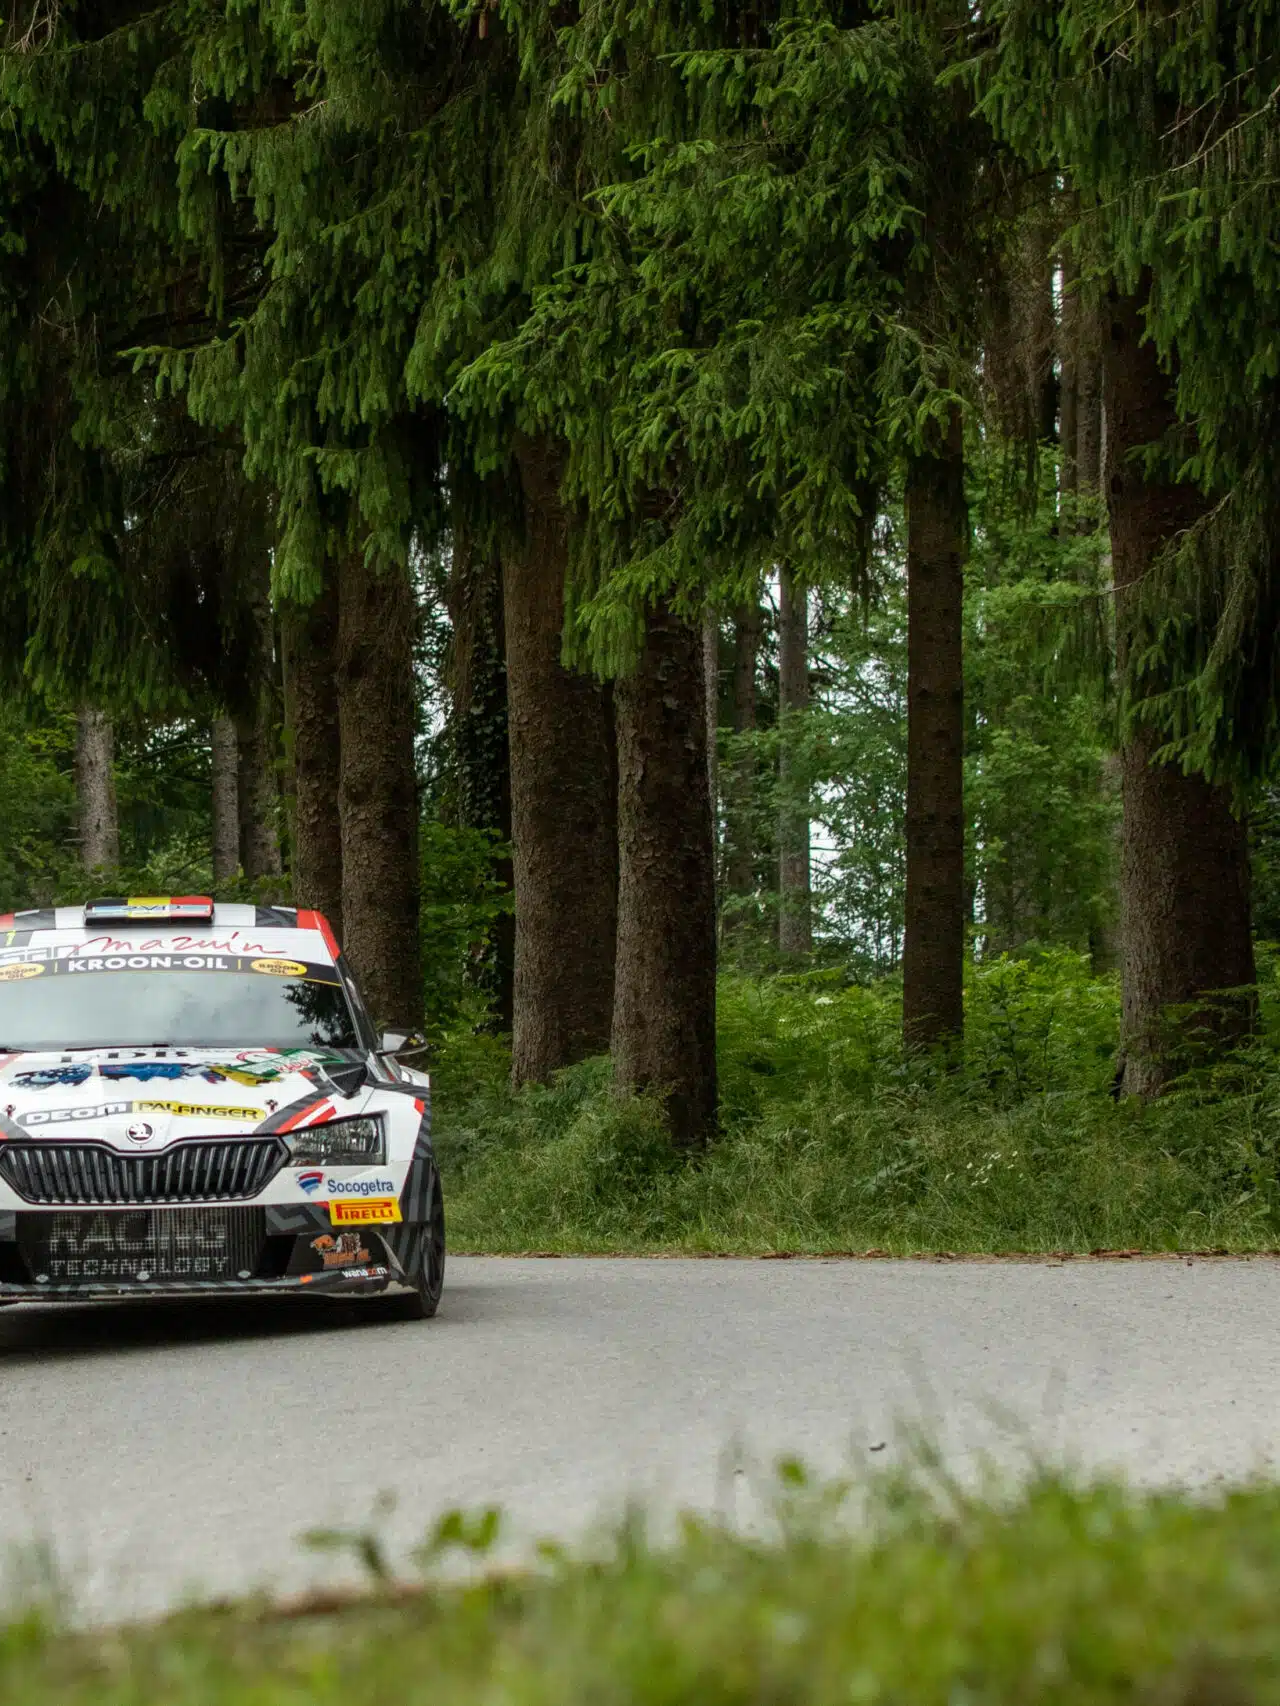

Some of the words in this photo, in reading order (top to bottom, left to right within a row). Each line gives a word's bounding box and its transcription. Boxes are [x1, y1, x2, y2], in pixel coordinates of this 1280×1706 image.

[5, 929, 17, 947] 1
[68, 956, 228, 972] KROON-OIL
[139, 1101, 259, 1120] PALFINGER
[327, 1179, 395, 1196] Socogetra
[335, 1201, 394, 1220] PIRELLI
[50, 1256, 230, 1276] TECHNOLOGY
